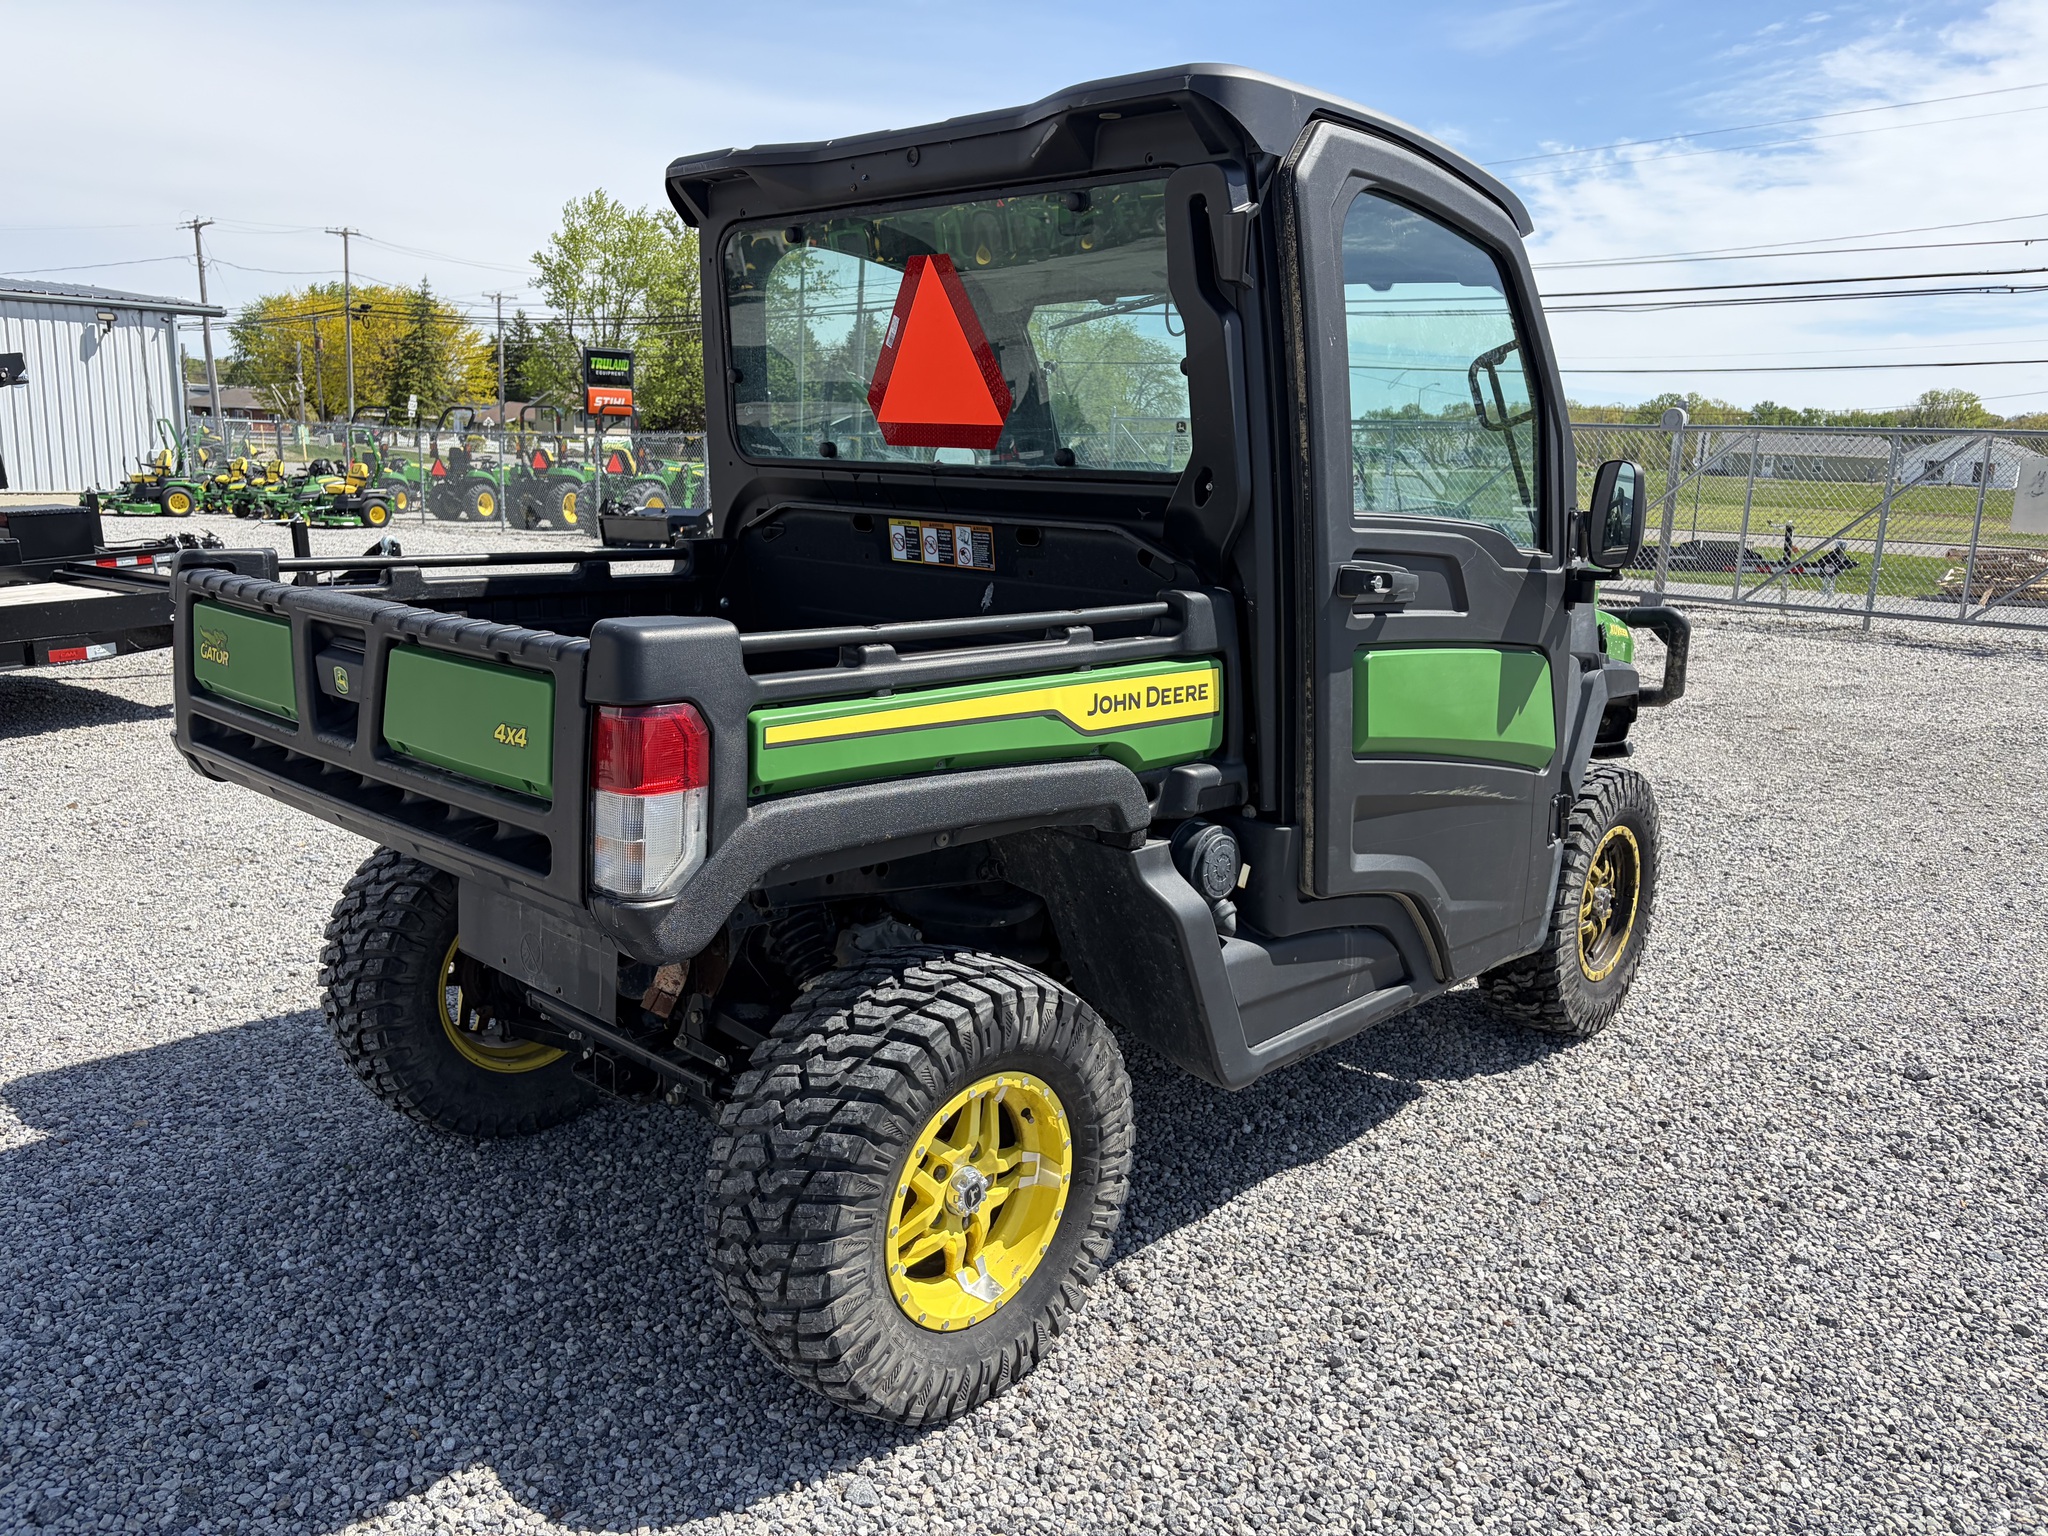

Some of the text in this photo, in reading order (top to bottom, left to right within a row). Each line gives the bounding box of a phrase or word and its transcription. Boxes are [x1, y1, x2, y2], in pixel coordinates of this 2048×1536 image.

[590, 357, 630, 371] TRULAND
[200, 642, 229, 666] GATOR
[1087, 683, 1209, 716] JOHN DEERE
